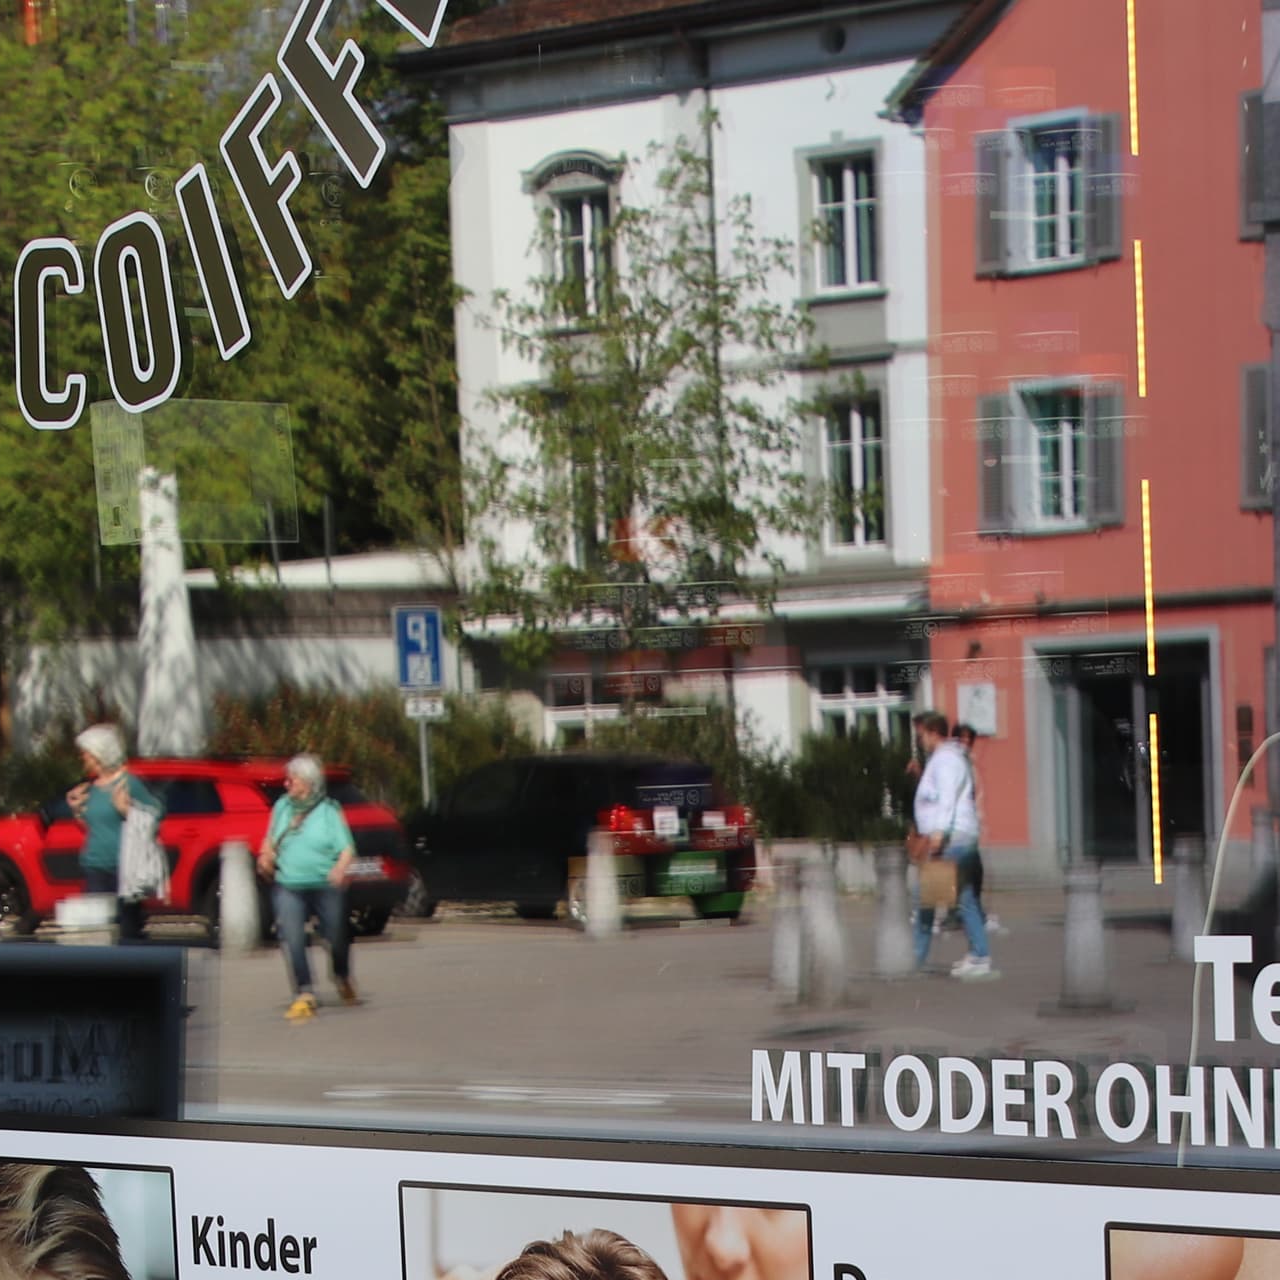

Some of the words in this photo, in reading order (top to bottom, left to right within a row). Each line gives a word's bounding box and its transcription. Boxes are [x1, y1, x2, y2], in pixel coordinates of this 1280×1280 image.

[13, 0, 448, 430] COIFF
[749, 1048, 867, 1127] MIT
[882, 1054, 1077, 1139] ODER
[190, 1214, 319, 1276] Kinder
